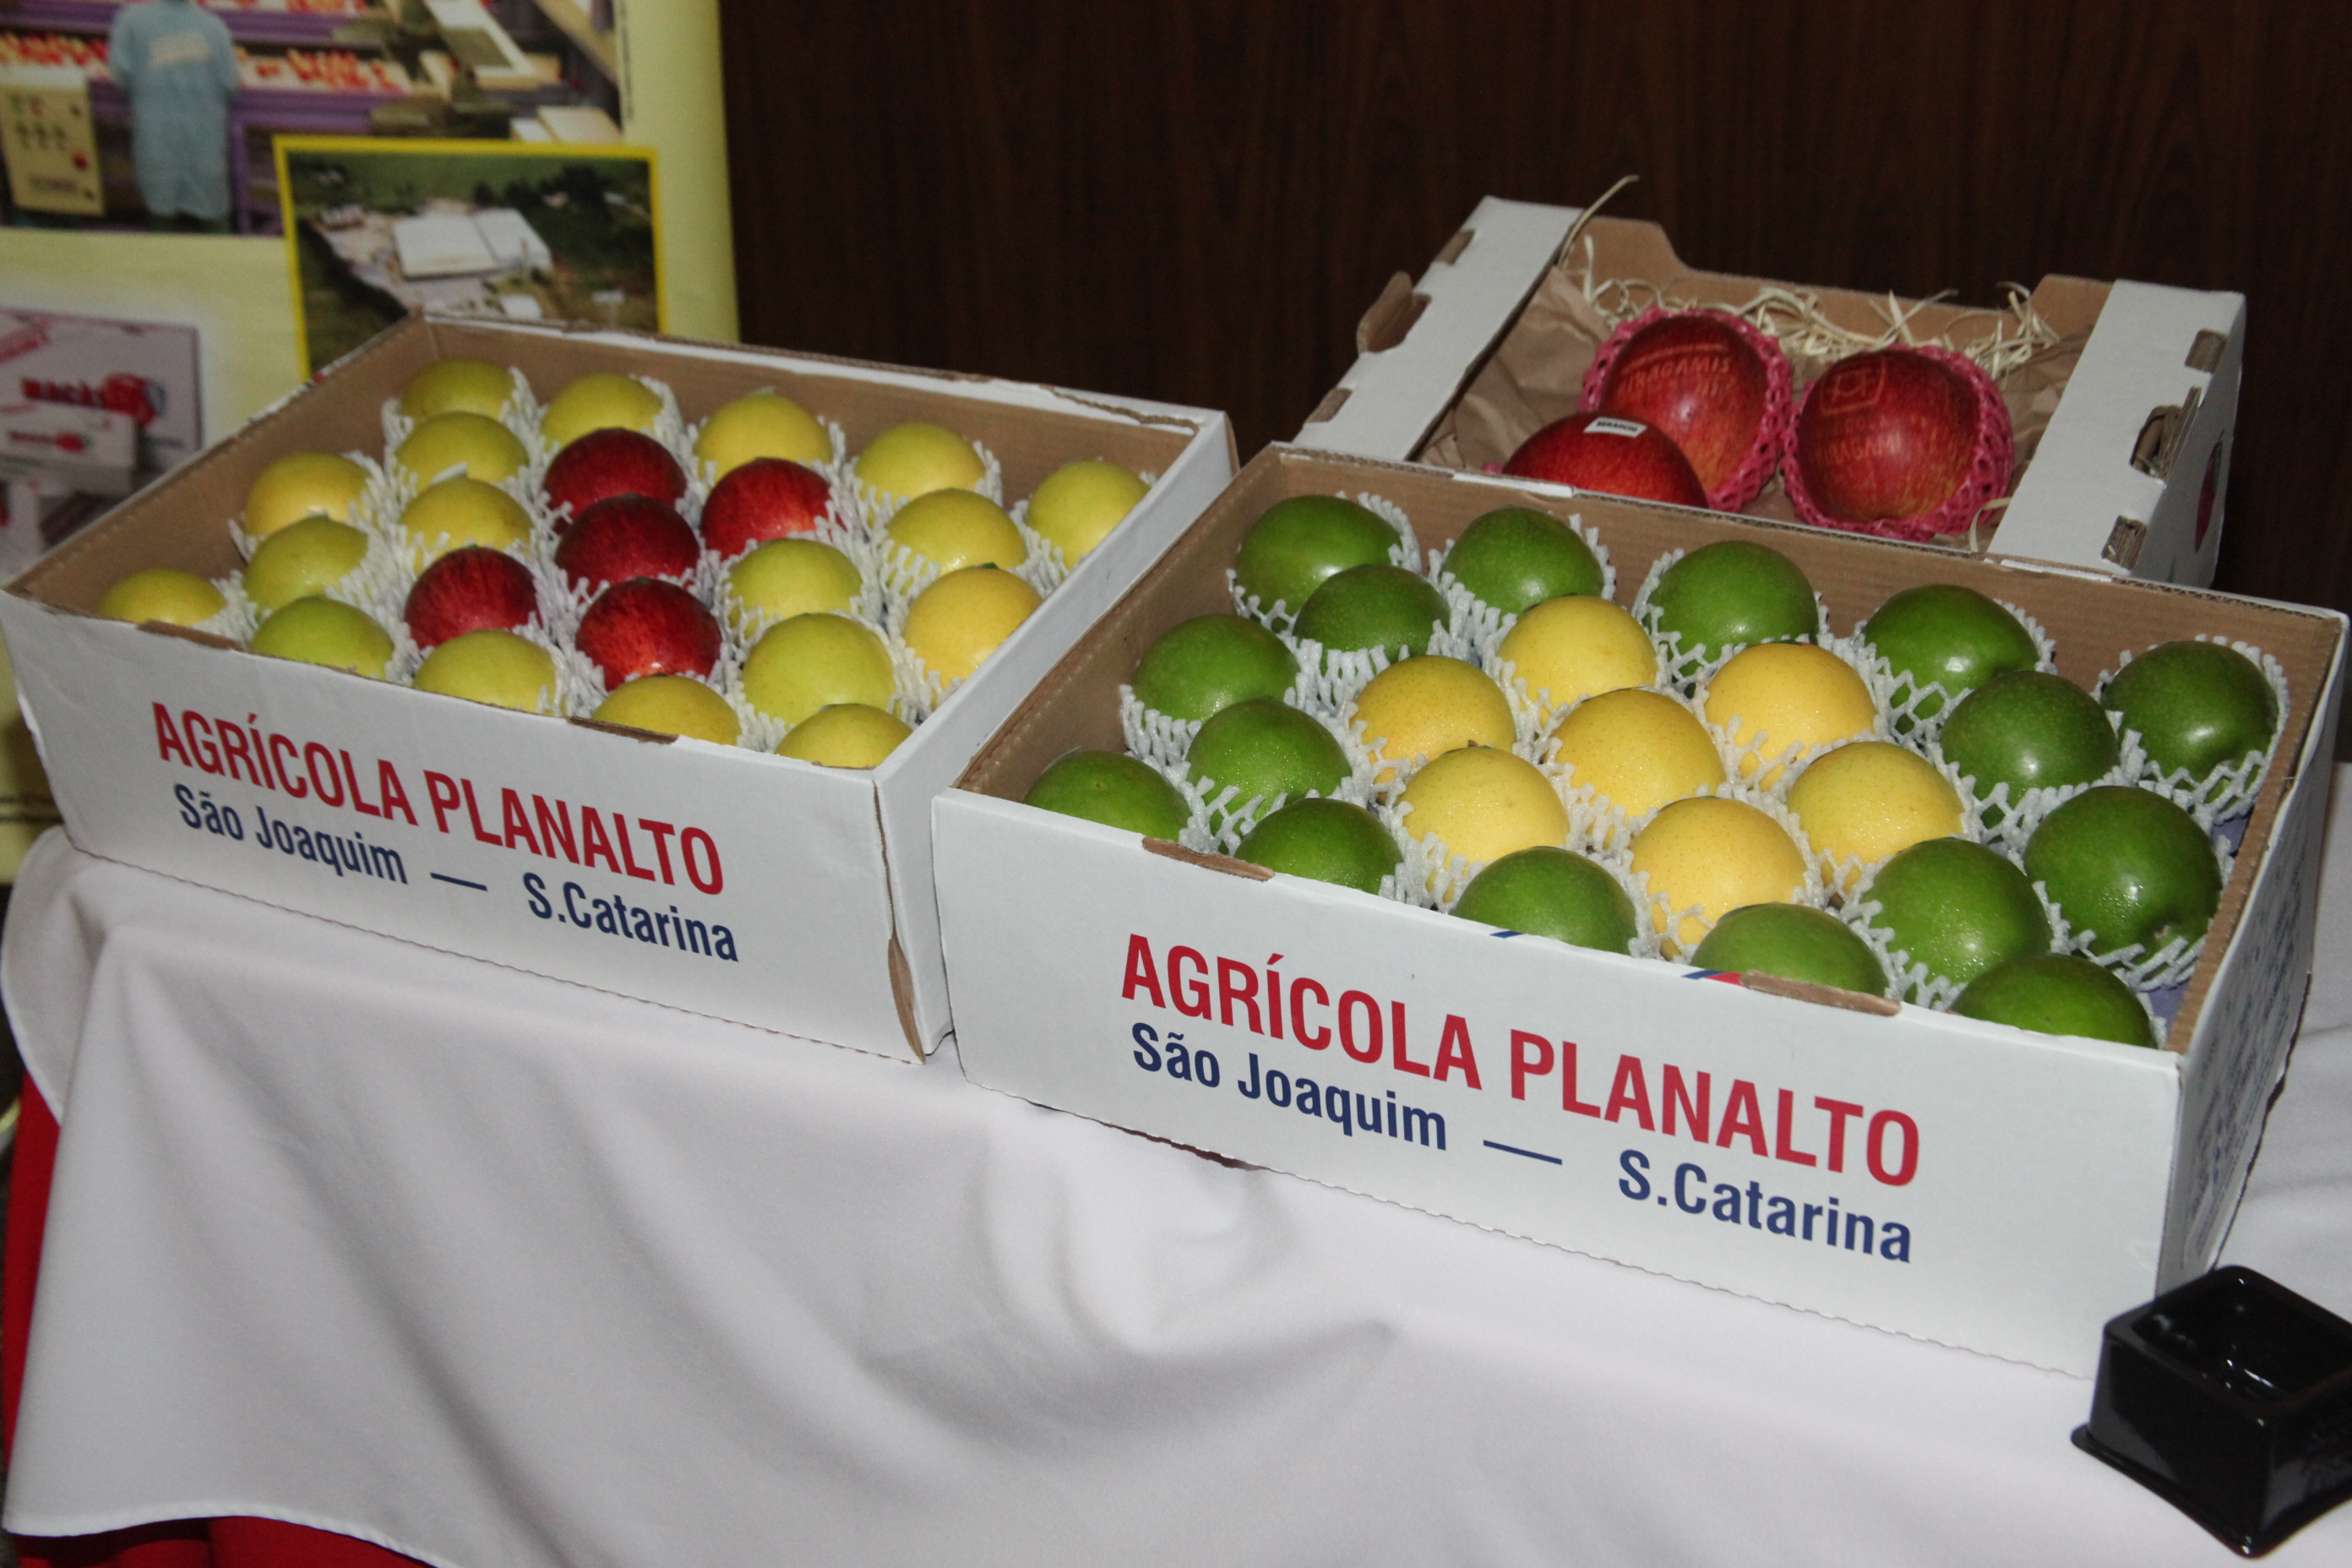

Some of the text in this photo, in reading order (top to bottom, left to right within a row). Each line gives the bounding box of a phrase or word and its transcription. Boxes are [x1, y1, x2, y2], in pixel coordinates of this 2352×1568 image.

[151, 701, 725, 896] AGRÍCOLA PLANALTO
[174, 783, 244, 841] São
[255, 804, 409, 885] Joaquim
[522, 871, 739, 962] S.Catarina
[1121, 934, 1920, 1188] AGRÍCOLA PLANALTO
[1131, 1023, 1222, 1088] São
[1237, 1053, 1447, 1151] Joaquim
[1618, 1149, 1913, 1264] S.Catarina
